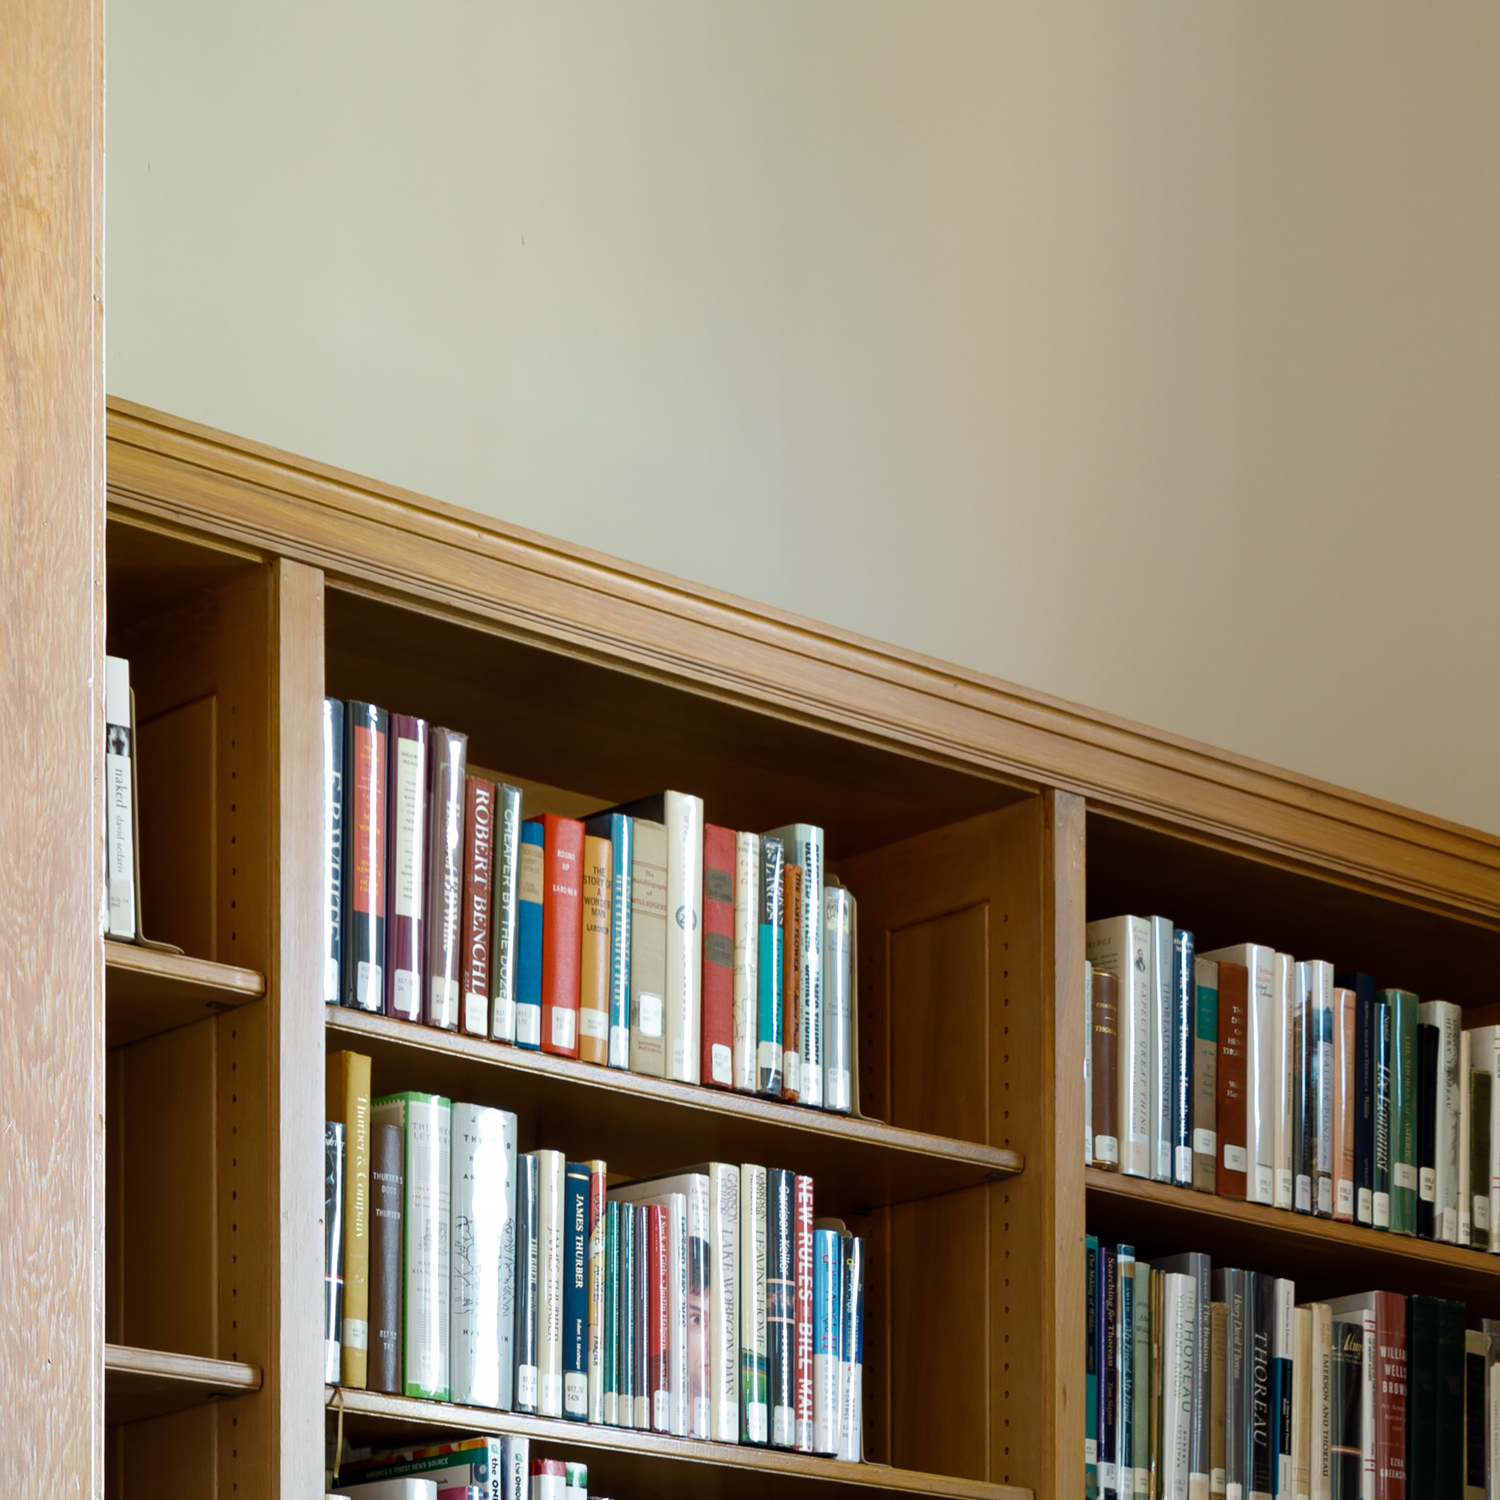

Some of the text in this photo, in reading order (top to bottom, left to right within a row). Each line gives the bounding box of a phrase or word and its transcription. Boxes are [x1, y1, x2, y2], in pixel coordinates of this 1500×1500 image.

[114, 768, 127, 809] naked
[474, 788, 490, 887] ROBERT
[355, 1093, 369, 1239] Thurber & Company
[372, 1171, 403, 1185] THURBER'S
[381, 1184, 397, 1195] DOGS
[376, 1208, 401, 1220] THURBER
[574, 1193, 585, 1289] JAMES THURBER
[1254, 1332, 1268, 1447] THOREAU
